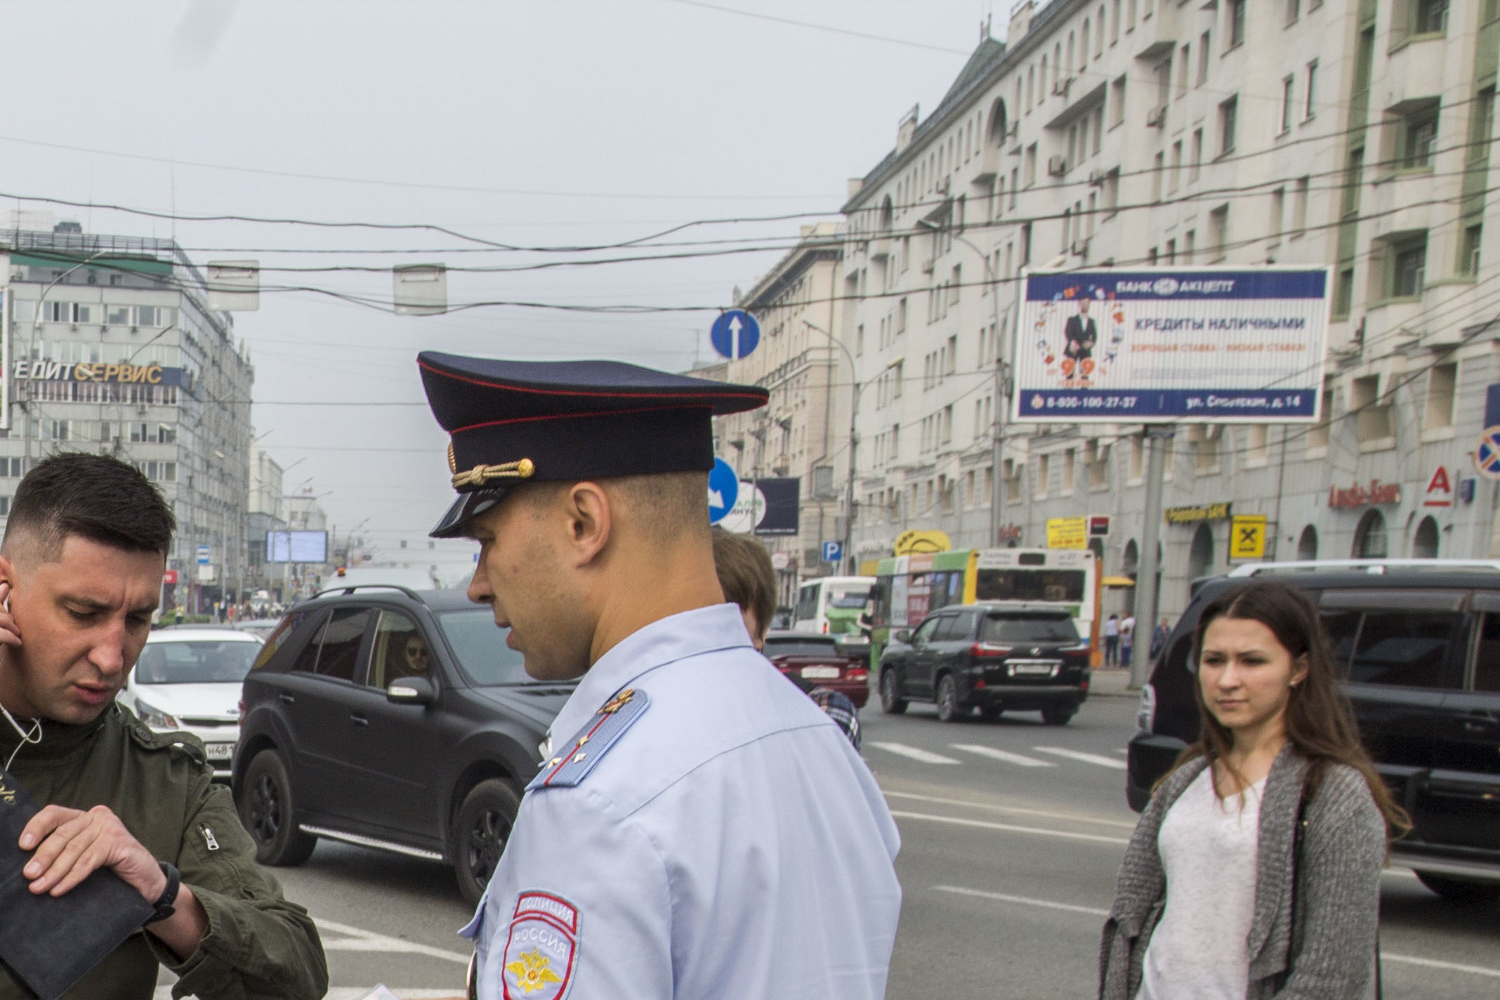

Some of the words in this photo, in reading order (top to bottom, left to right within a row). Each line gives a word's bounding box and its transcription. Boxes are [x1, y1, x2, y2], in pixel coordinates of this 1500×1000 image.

[1115, 280, 1153, 294] БАНК
[1178, 279, 1236, 294] АКЦЕПТ
[1134, 317, 1204, 331] КРЕДИТЫ
[1208, 316, 1306, 331] НАЛИЧНЫМИ
[1180, 343, 1217, 353] СТАВКА
[13, 360, 163, 383] ЕДИТСЕРВИС
[1045, 395, 1138, 409] 8-800-100-27-37
[1185, 397, 1204, 410] ул.
[520, 897, 574, 923] ПОЛИЦИЯ
[513, 929, 566, 958] РОССИЯ
